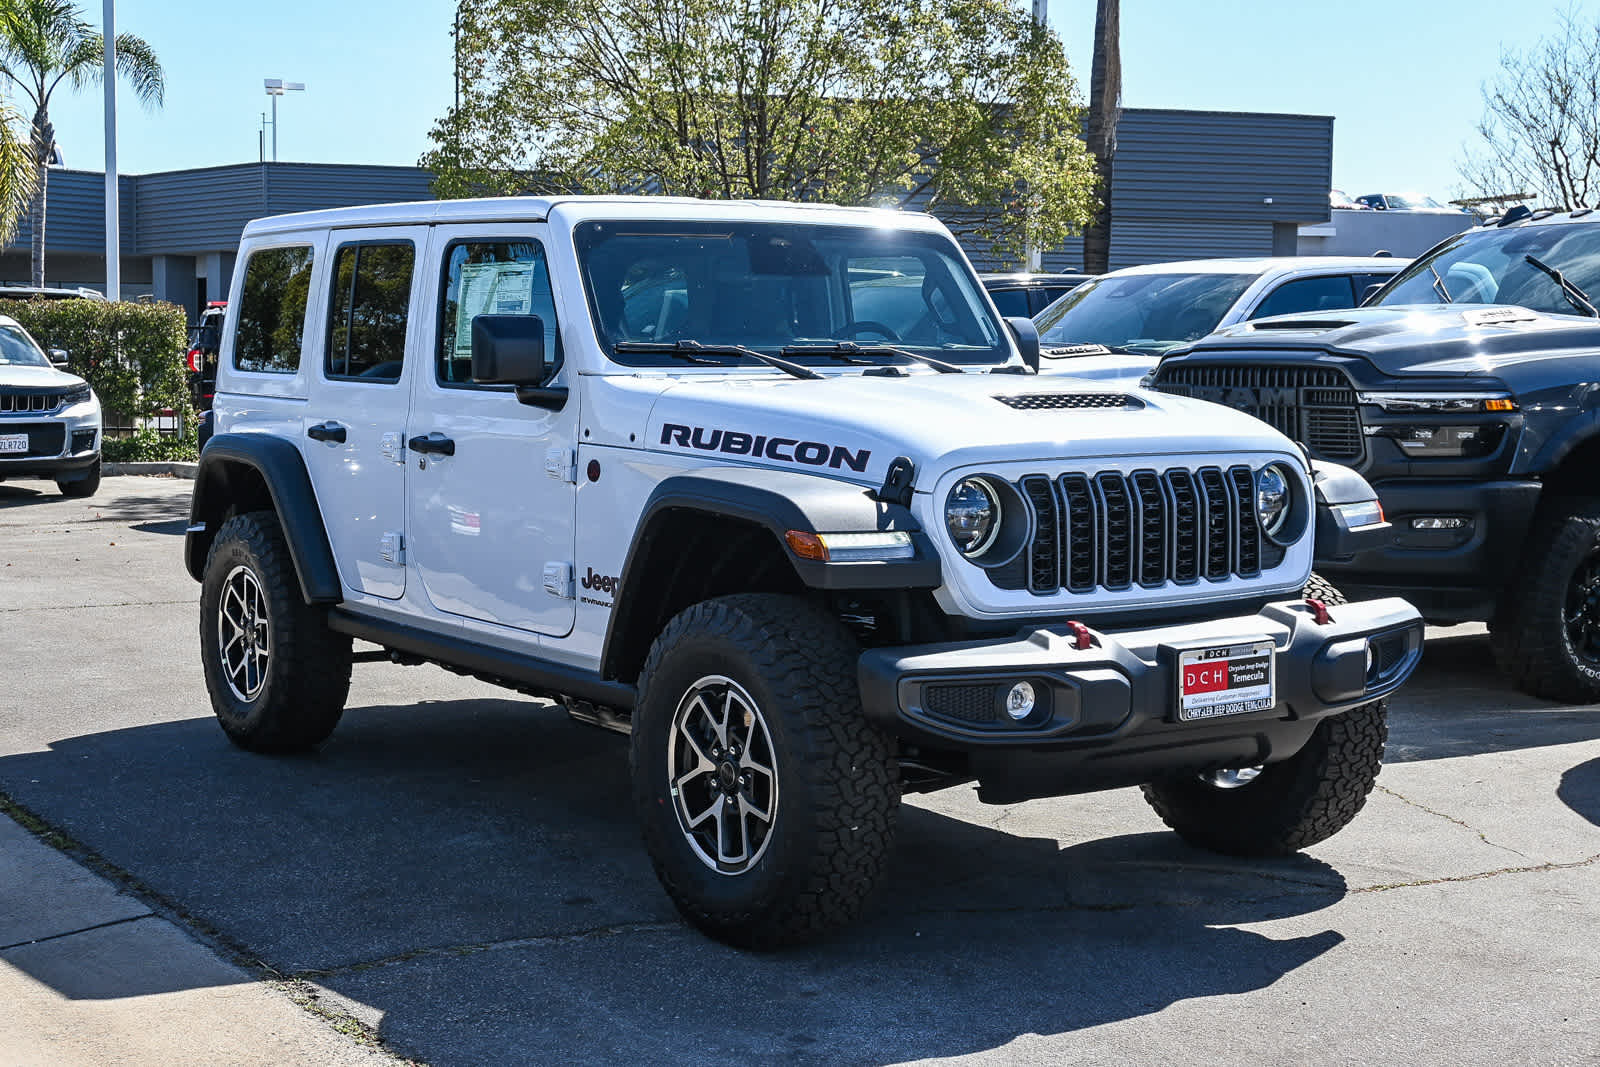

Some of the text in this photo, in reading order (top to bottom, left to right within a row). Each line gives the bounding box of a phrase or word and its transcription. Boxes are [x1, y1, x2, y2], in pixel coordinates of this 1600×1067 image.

[660, 423, 872, 472] RUBICON
[1187, 669, 1223, 687] DCH
[1232, 671, 1264, 682] Temecula
[1187, 698, 1270, 718] CHRYSLER JEEP DODGE TEMECULA
